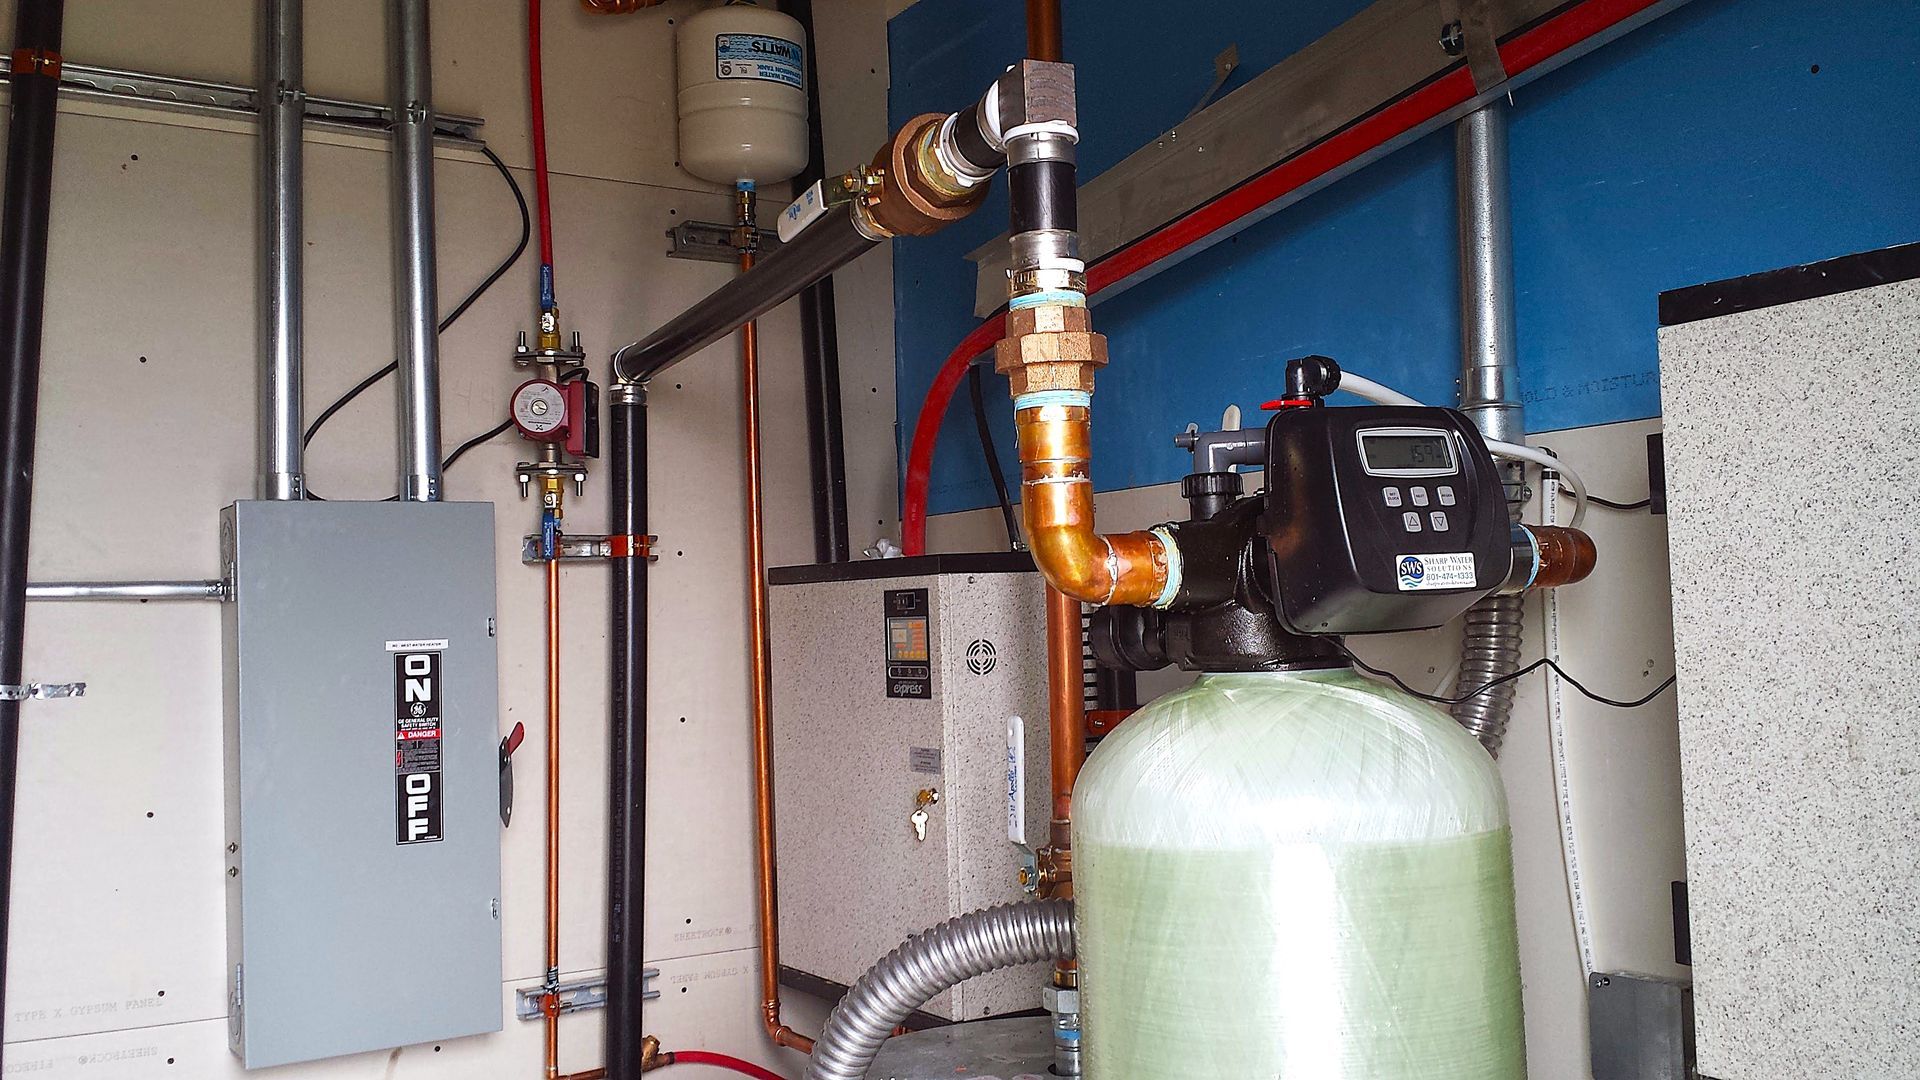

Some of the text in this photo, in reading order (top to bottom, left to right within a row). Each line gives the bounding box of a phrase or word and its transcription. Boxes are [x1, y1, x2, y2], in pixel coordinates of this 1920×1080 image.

[751, 41, 791, 59] WATTS
[757, 64, 774, 72] TANK
[759, 71, 780, 80] WATER
[1424, 555, 1473, 565] SHARP WATER
[1401, 561, 1422, 575] SWS
[1426, 564, 1472, 572] SOLUTIONS
[1426, 572, 1474, 581] 801-474-1333
[404, 654, 431, 702] ON
[893, 684, 922, 697] express
[408, 730, 437, 738] DANGER
[405, 772, 432, 842] OFF
[14, 996, 164, 1023] TYPE X GYPSUM PANEL
